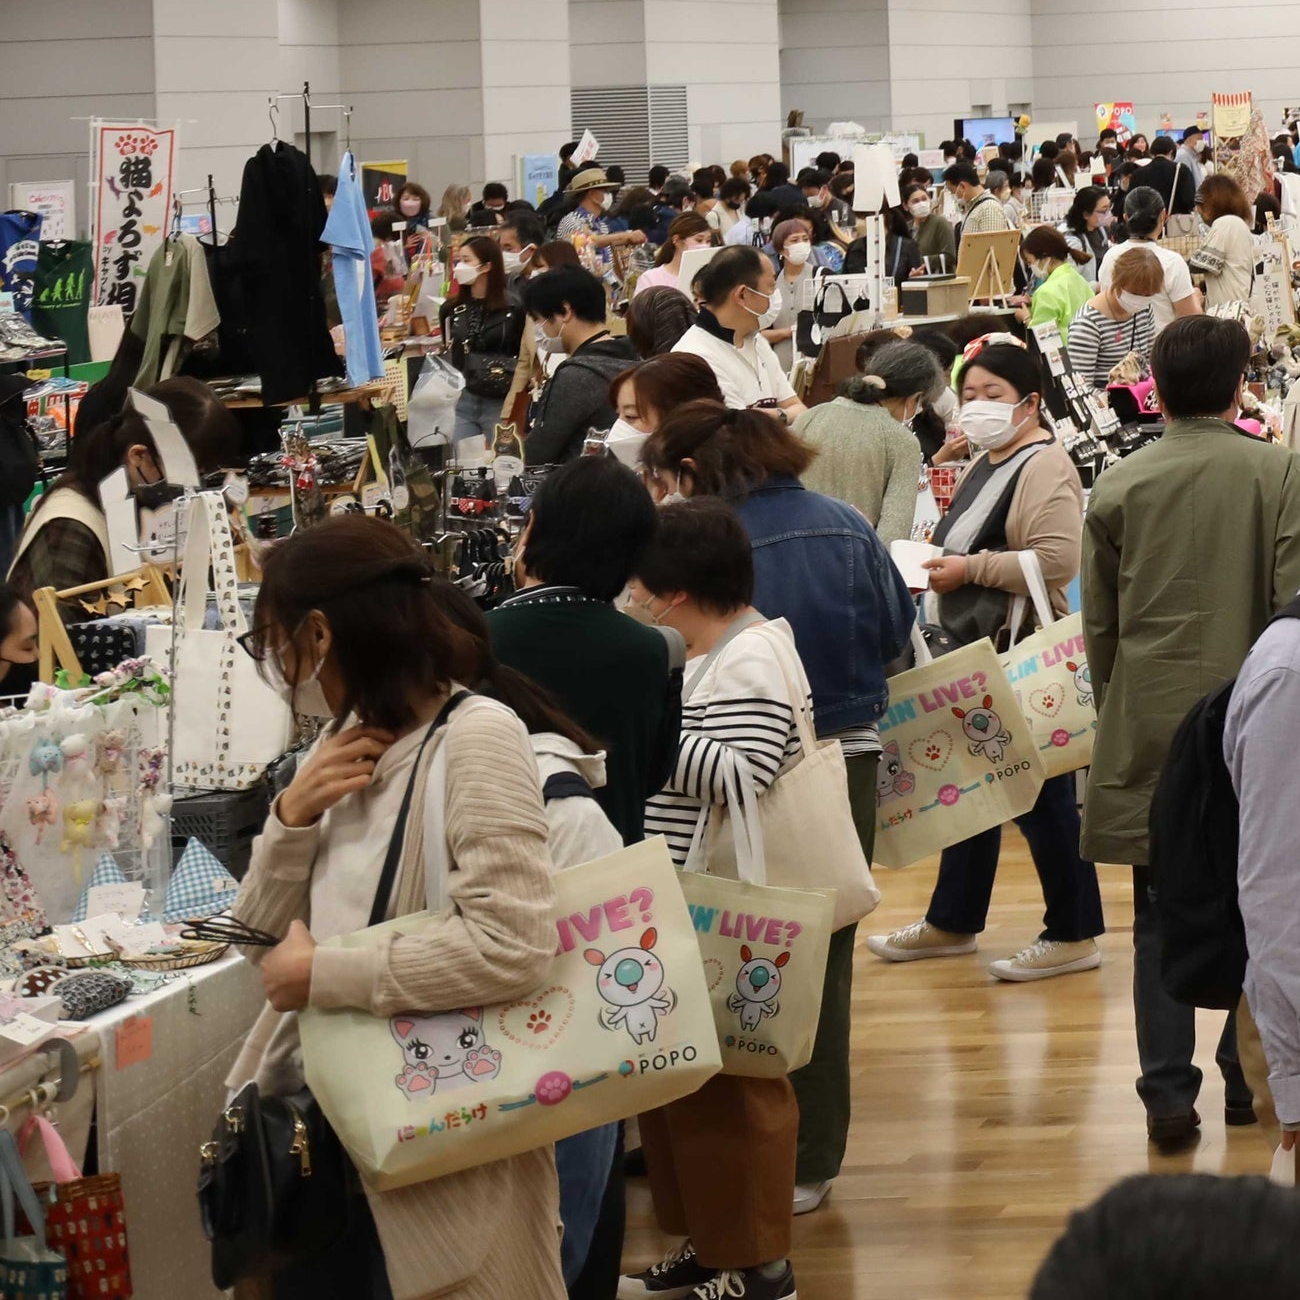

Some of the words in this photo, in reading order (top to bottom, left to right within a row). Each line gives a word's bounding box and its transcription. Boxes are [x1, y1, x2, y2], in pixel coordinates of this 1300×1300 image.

[918, 671, 988, 714] LIVE?
[996, 760, 1031, 780] POPO
[555, 886, 654, 957] IVE?
[718, 909, 804, 948] LIVE?
[639, 1045, 697, 1075] POPO
[738, 1039, 778, 1056] POPO
